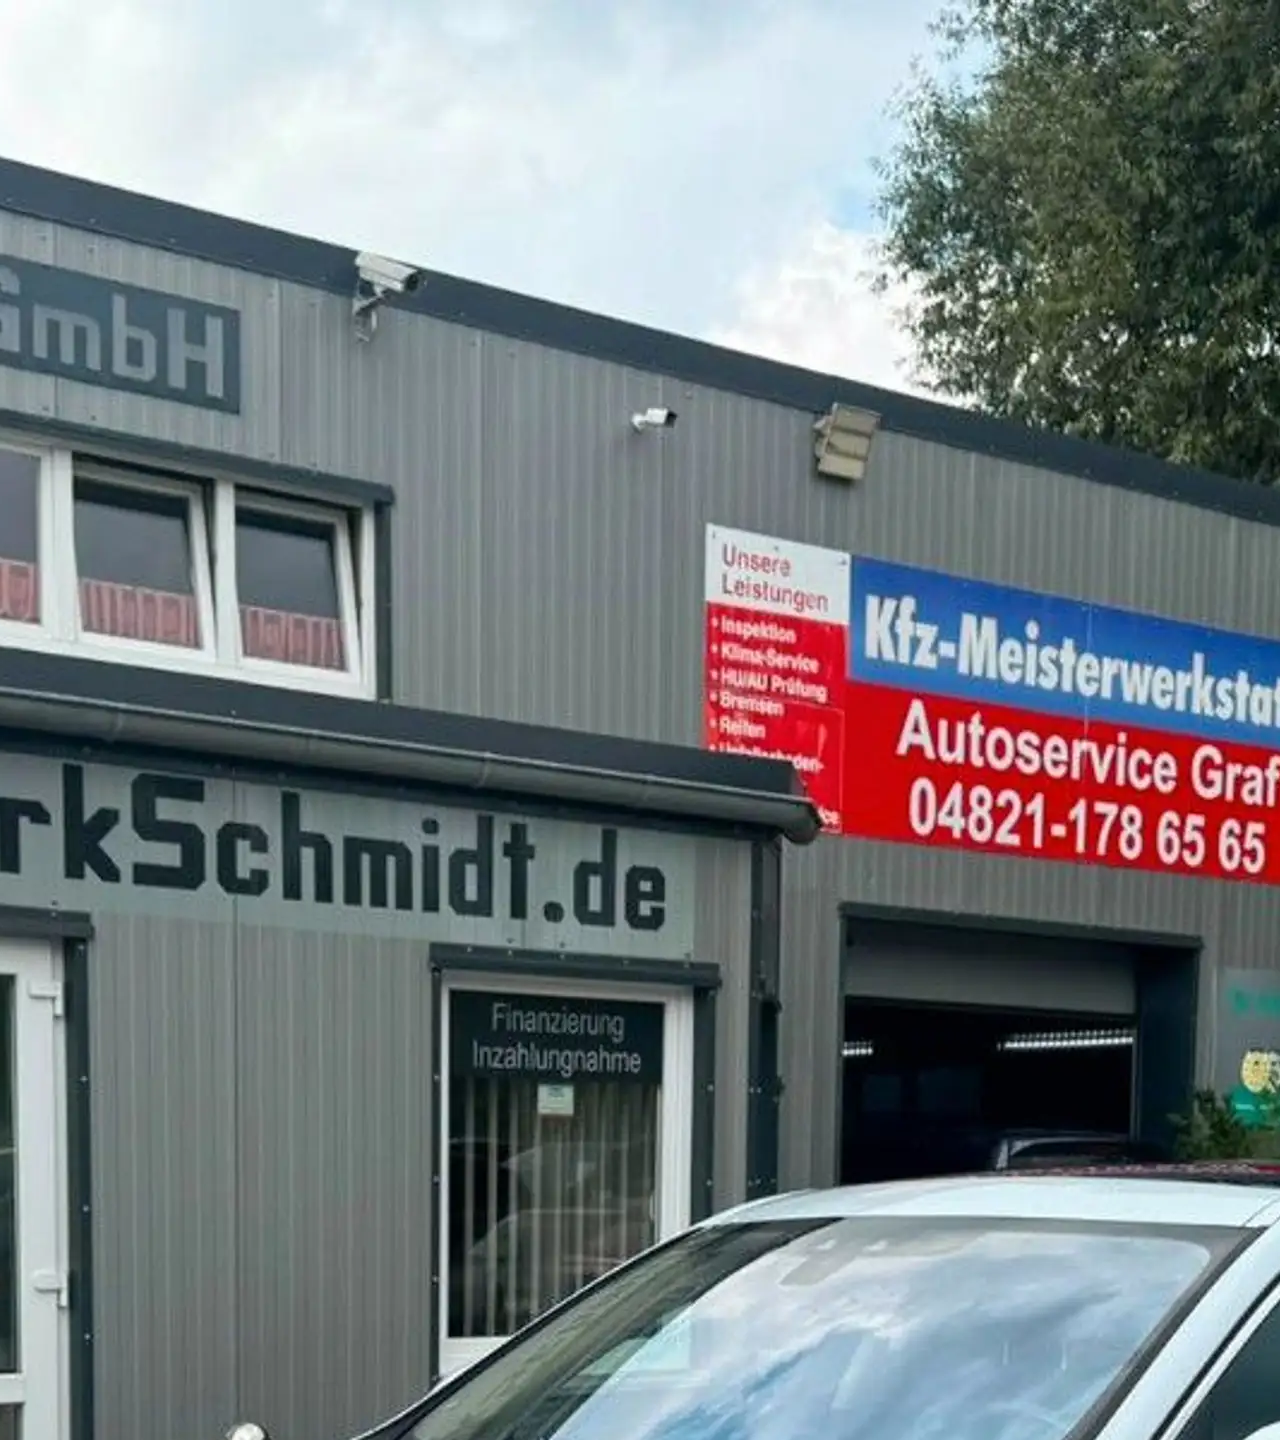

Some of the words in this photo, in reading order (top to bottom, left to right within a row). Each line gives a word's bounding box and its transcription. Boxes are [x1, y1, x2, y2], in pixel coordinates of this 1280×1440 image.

[722, 542, 791, 577] Unsere
[722, 573, 829, 612] Leistungen
[721, 615, 797, 644] Inspektion
[721, 641, 820, 674] Klima-Service
[720, 690, 785, 717] Bremsen
[770, 674, 828, 703] Prüfung
[720, 715, 767, 739] Reifen
[897, 698, 1178, 795] Autoservice
[909, 776, 1143, 861] 04821-178
[1156, 815, 1207, 868] 65
[1219, 820, 1266, 875] 65
[491, 1002, 626, 1044] Finanzierung
[472, 1040, 642, 1078] Inzahlungnahme
